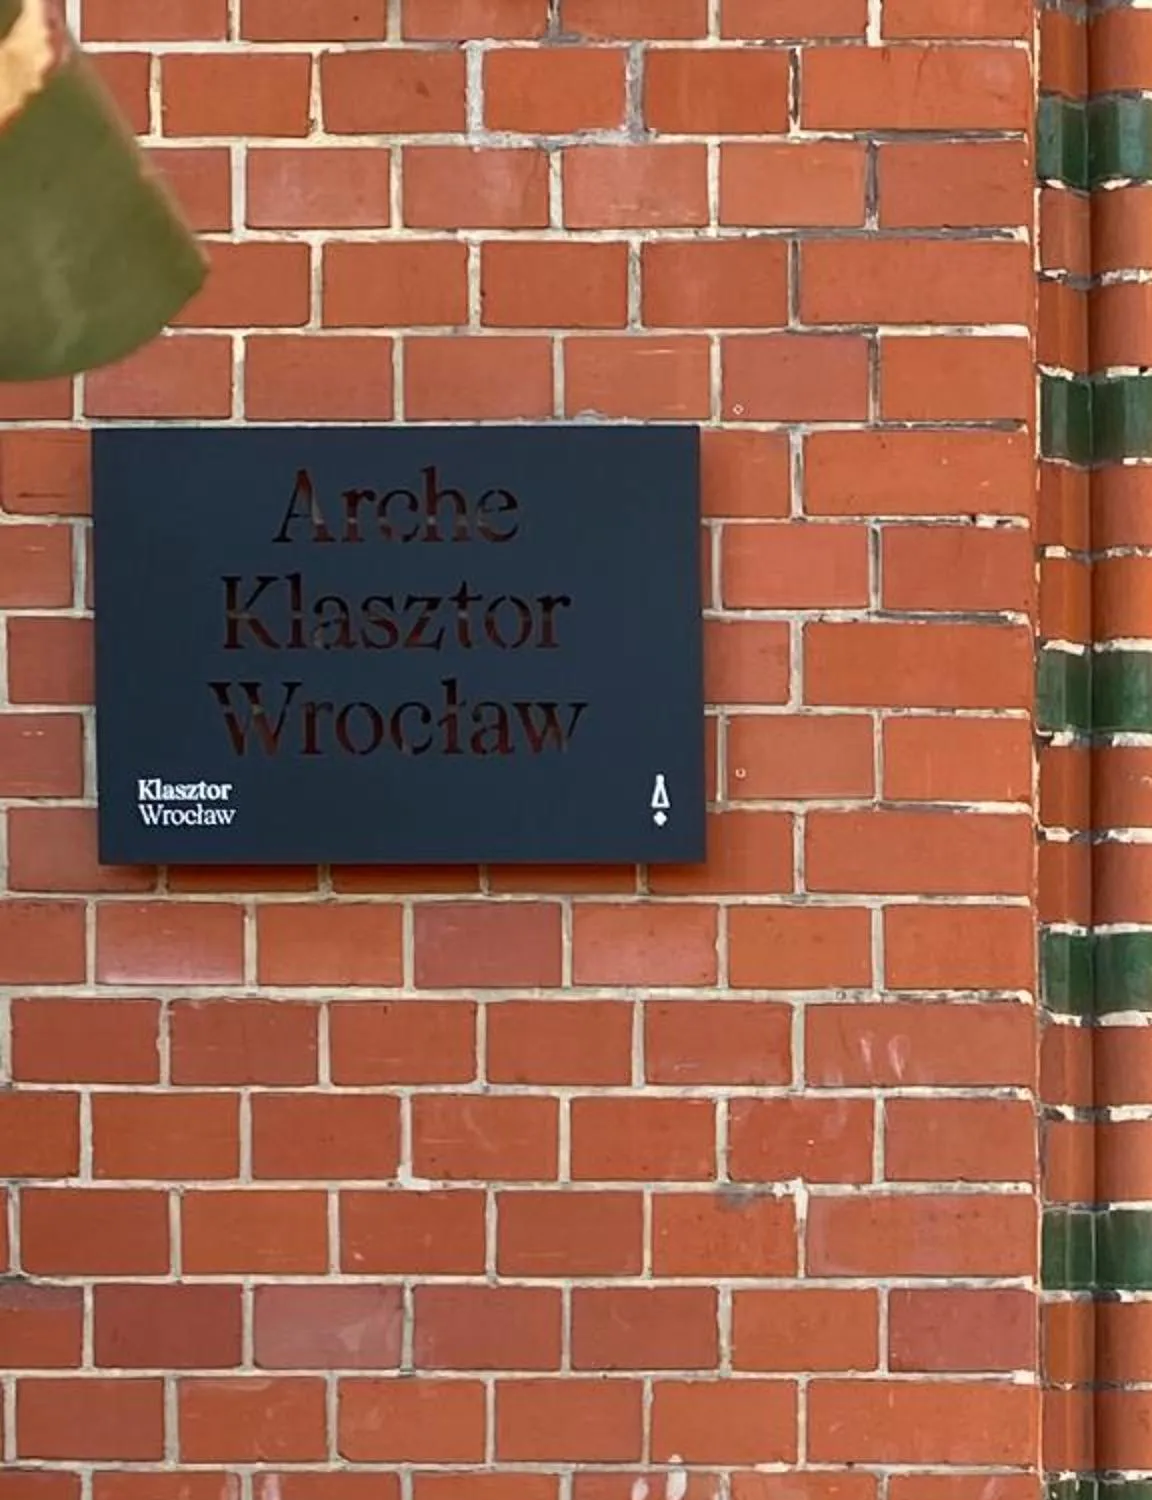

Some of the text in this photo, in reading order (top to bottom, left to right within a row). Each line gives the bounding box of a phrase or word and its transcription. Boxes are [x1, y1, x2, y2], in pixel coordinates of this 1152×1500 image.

[272, 466, 519, 543] Arche
[221, 573, 571, 651] Klasztor
[208, 679, 588, 756] Wrocław
[138, 778, 232, 801] Klasztor
[138, 803, 236, 826] Wrocław
